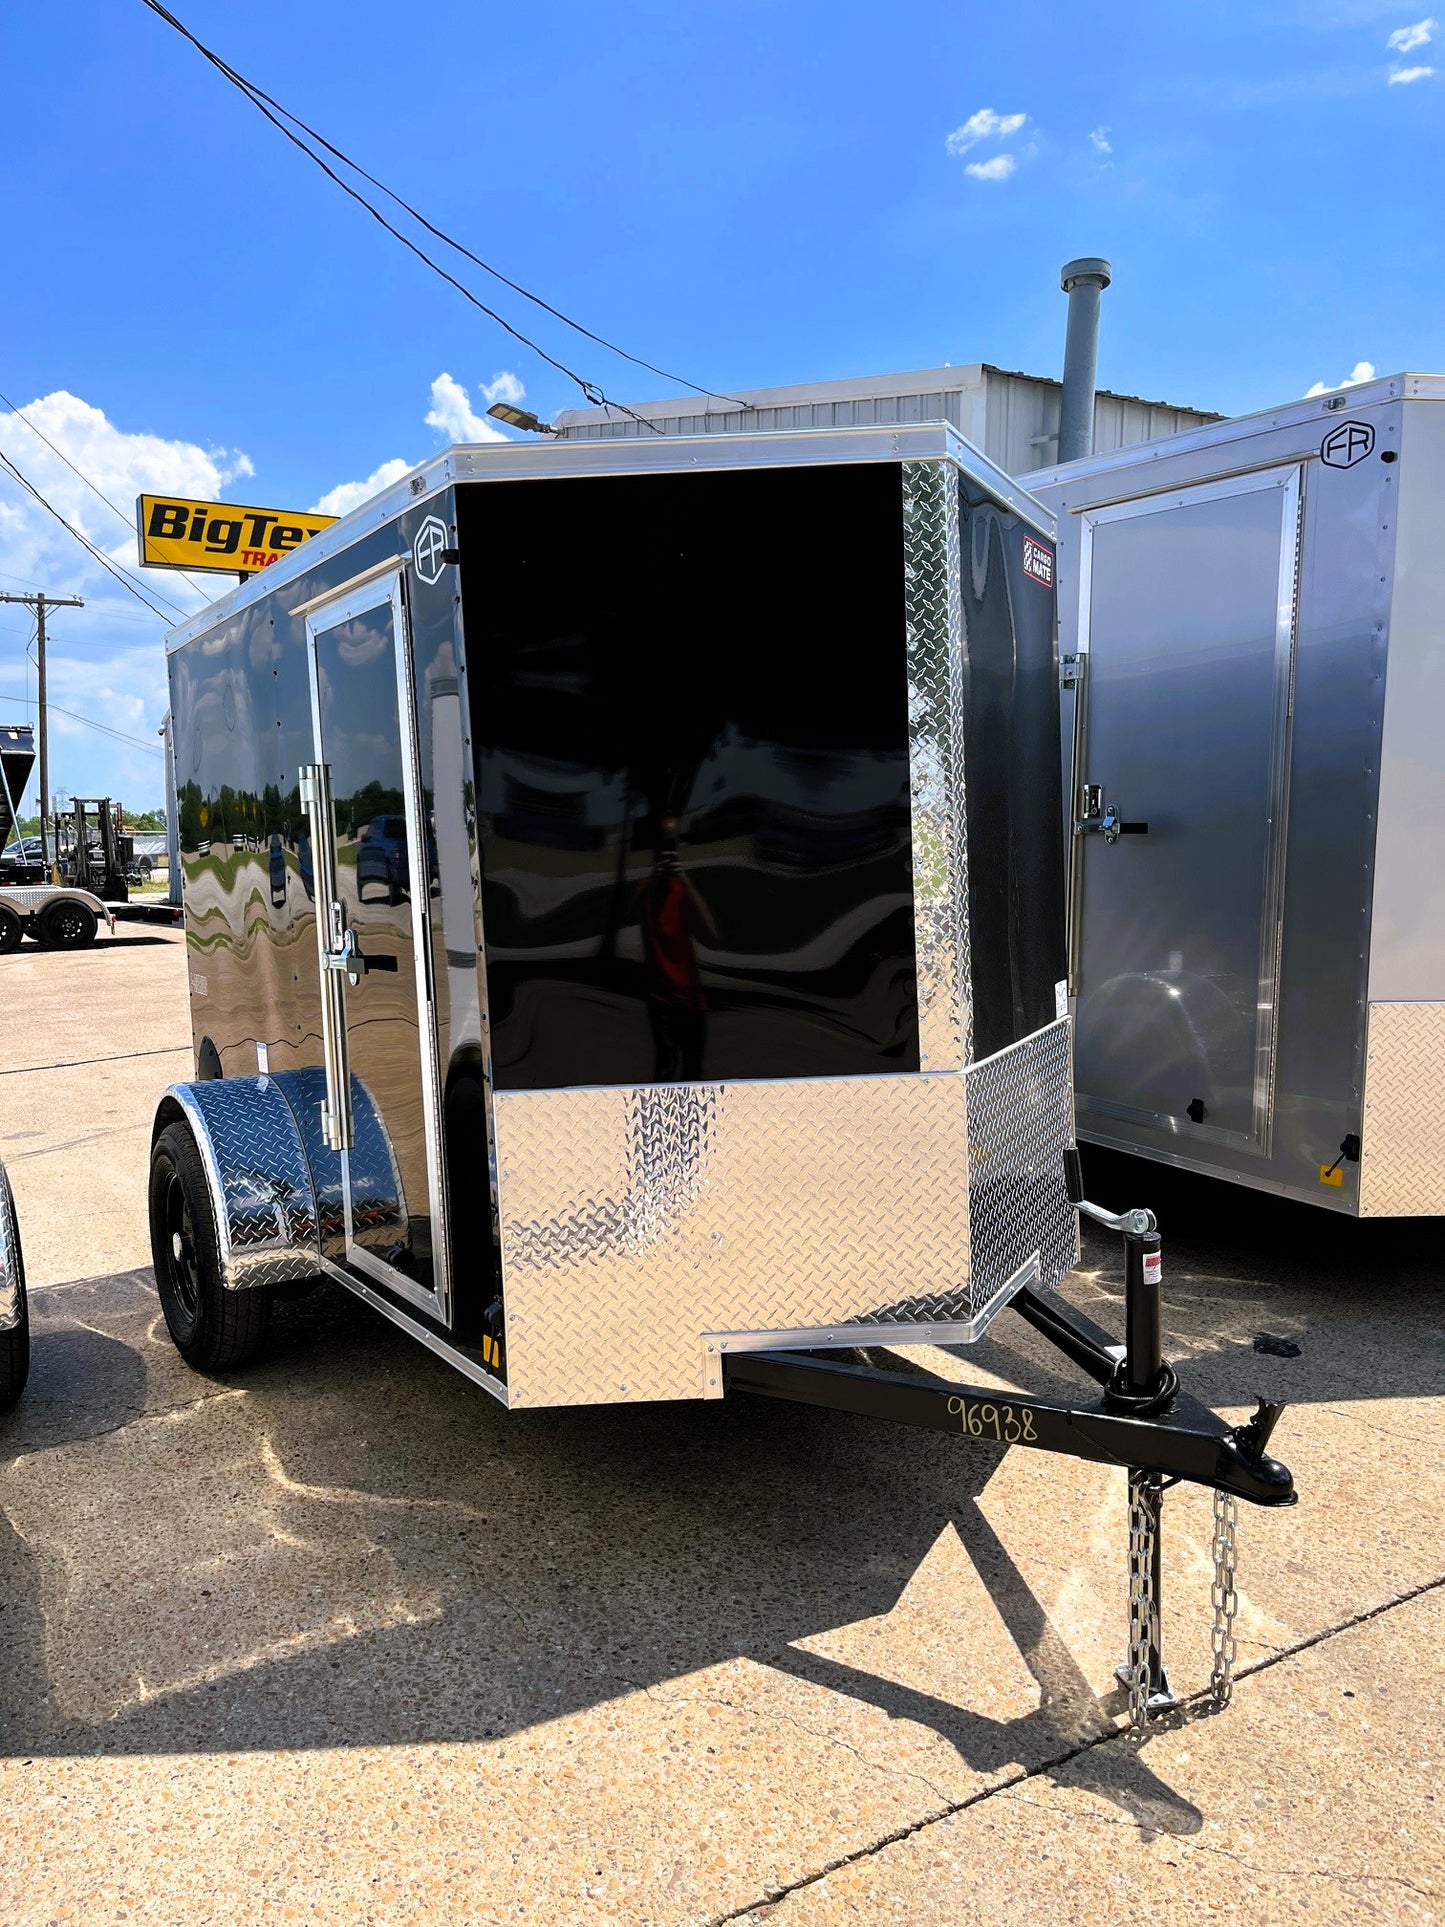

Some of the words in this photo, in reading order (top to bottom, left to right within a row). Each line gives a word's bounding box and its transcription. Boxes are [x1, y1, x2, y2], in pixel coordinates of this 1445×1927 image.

[240, 550, 285, 567] TRA
[1033, 547, 1052, 567] CARGO
[1032, 559, 1051, 582] MATE
[947, 1396, 1038, 1443] 96938
